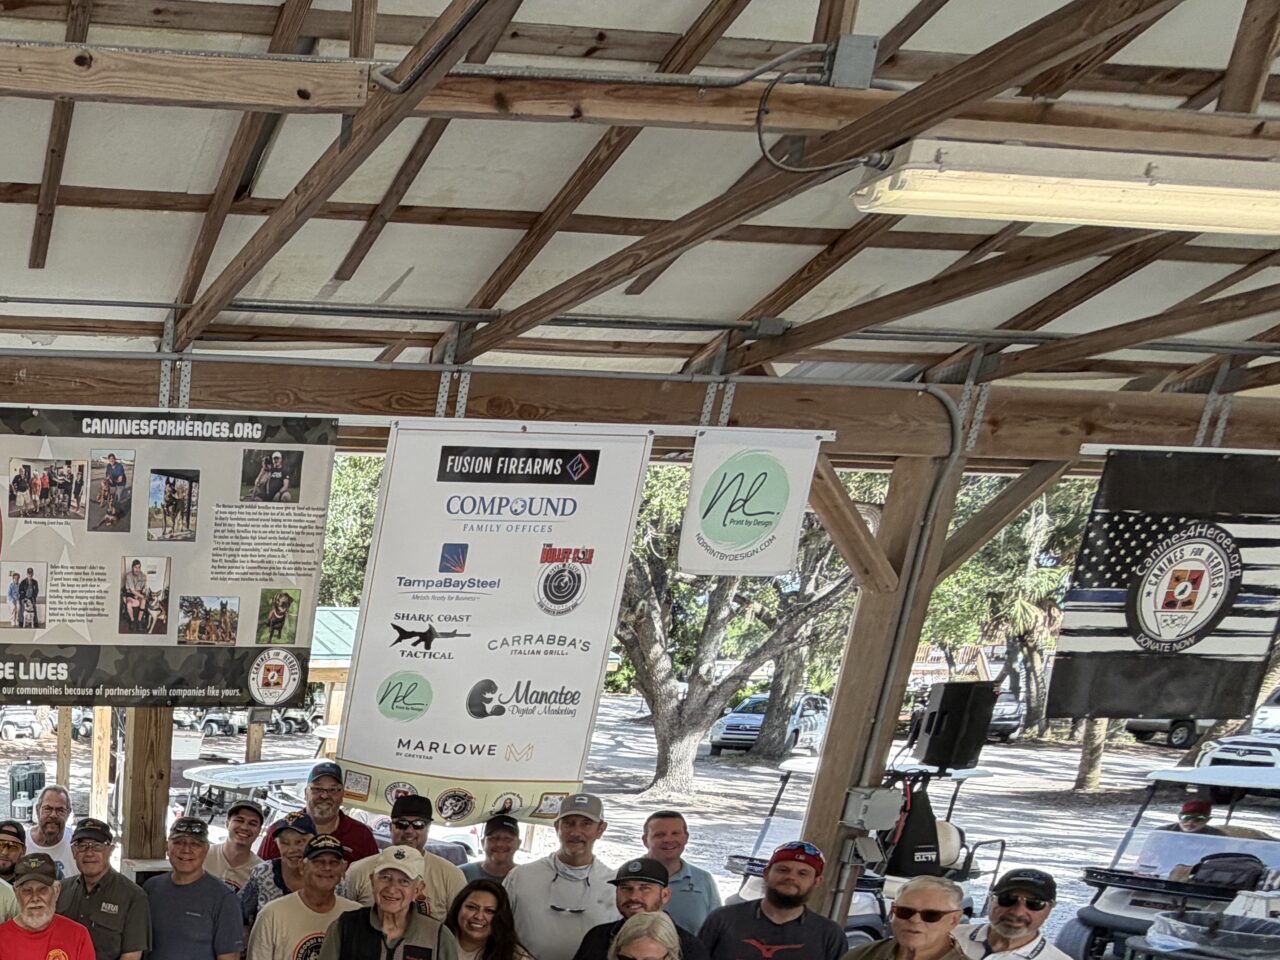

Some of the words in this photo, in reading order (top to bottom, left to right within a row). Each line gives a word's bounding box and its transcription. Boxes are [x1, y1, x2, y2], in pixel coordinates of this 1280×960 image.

[81, 417, 262, 439] CANINESFORHEROES.ORG
[446, 456, 493, 474] FUSION
[496, 457, 563, 475] FIREARMS
[446, 495, 578, 517] COMPOUND
[463, 523, 501, 533] FAMILY
[506, 524, 553, 533] OFFICES
[729, 518, 744, 526] Print
[745, 519, 752, 527] by
[753, 519, 773, 527] Design
[695, 532, 777, 562] NDPRINTBYDESIGN.COM
[1135, 523, 1242, 579] Canines4Heroes.org
[1148, 548, 1185, 587] CANINES
[1189, 547, 1205, 557] FOR
[1206, 550, 1224, 589] HEROES
[396, 576, 501, 591] TampaBaySteel
[393, 612, 433, 623] SHARK
[437, 613, 472, 623] COAST
[487, 634, 592, 652] CARRABBA'S
[1135, 633, 1171, 653] DONATE
[1171, 635, 1196, 652] NOW
[251, 651, 271, 676] CANINES
[283, 652, 299, 677] HEROES
[399, 649, 454, 660] TACTICAL
[18, 662, 69, 681] LIVES
[2, 685, 15, 694] our
[16, 685, 62, 695] communities
[64, 684, 94, 696] because
[95, 685, 103, 696] of
[104, 685, 151, 698] partnerships
[152, 686, 167, 697] with
[169, 686, 206, 698] companies
[207, 686, 220, 697] like
[221, 688, 241, 699] yours.
[498, 680, 581, 706] Manatee
[507, 705, 537, 717] Digital
[537, 706, 577, 718] Marketing
[396, 738, 497, 756] MARLOWE
